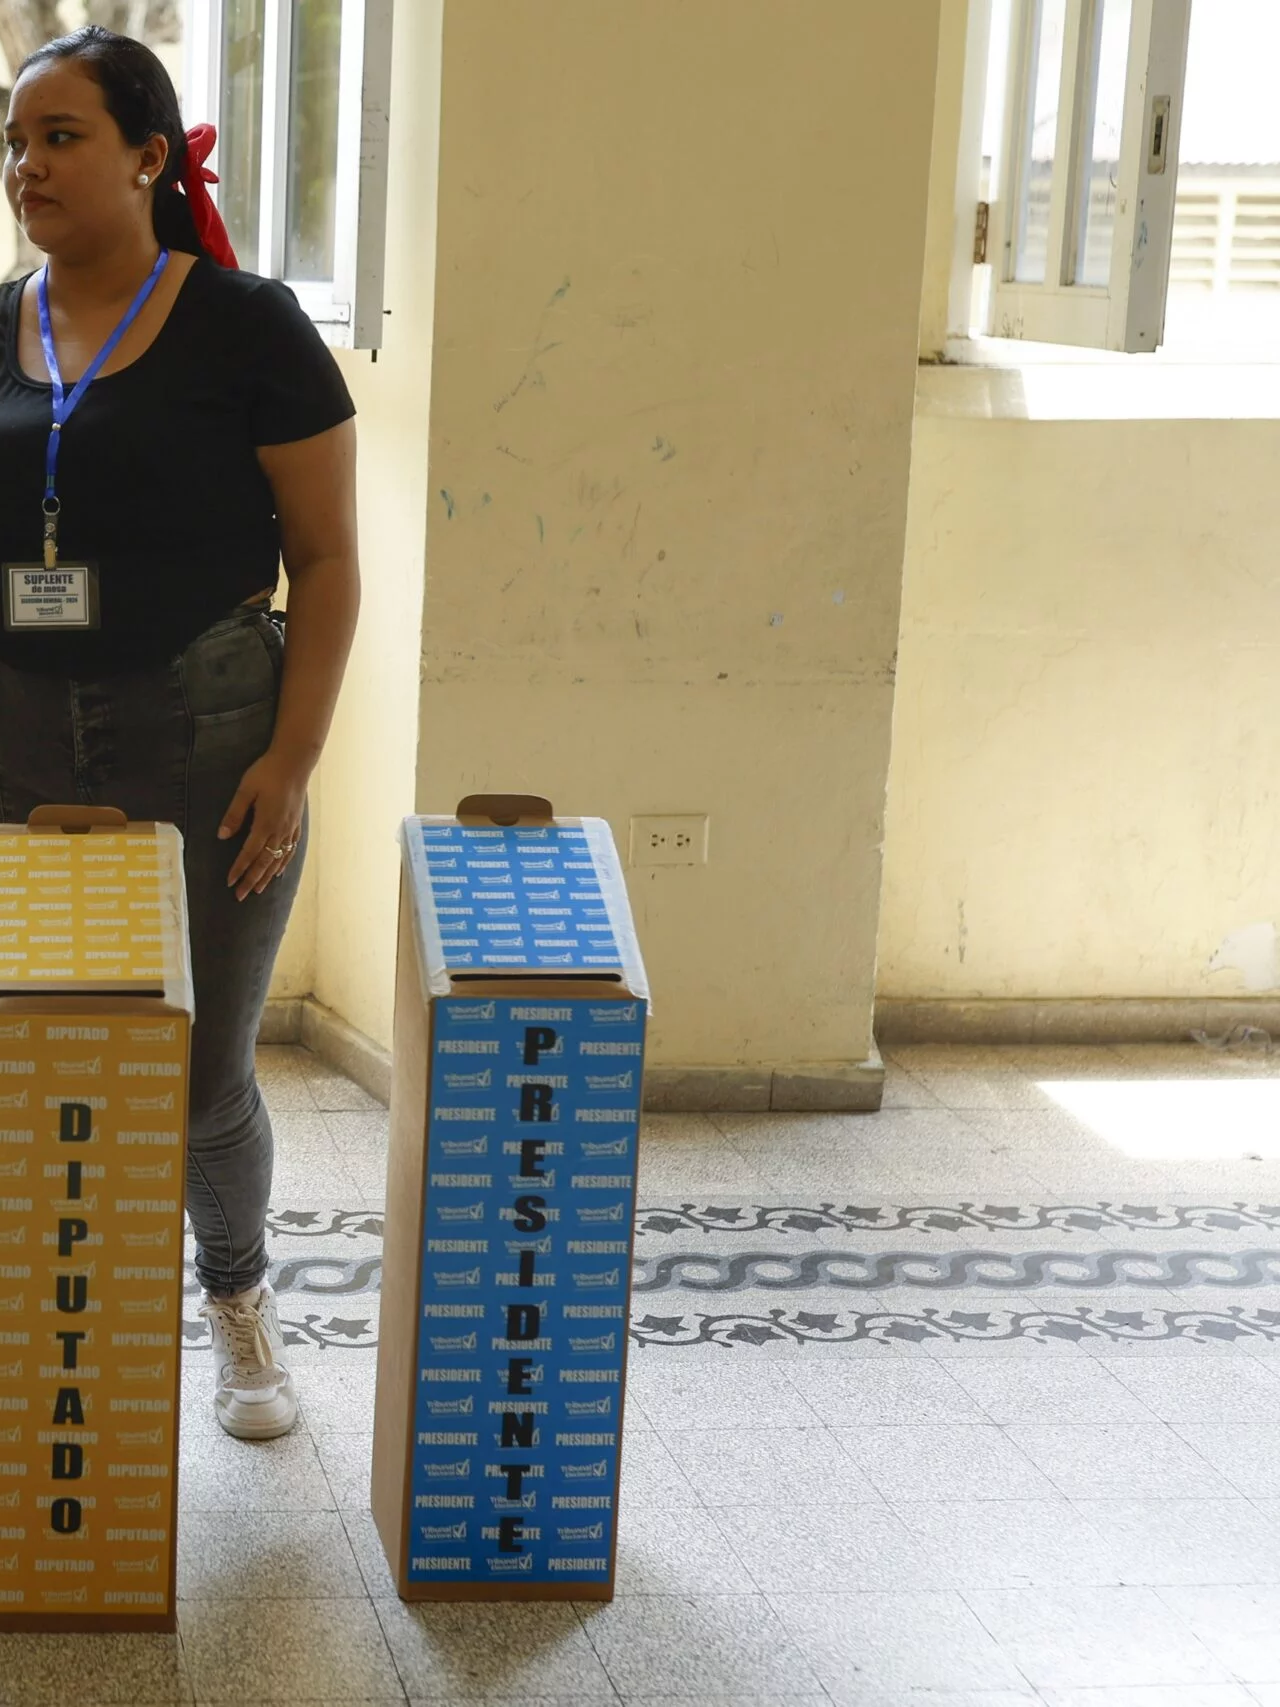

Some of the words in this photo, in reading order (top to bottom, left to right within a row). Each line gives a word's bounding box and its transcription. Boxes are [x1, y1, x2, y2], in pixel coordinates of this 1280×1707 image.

[24, 574, 74, 584] SUPLENTE
[510, 1008, 572, 1021] PRESIDENTE
[46, 1026, 109, 1040] DIPUTADO
[438, 1040, 500, 1054] PRESIDENTE
[580, 1042, 641, 1056] PRESIDENTE
[119, 1062, 181, 1076] DIPUTADO
[435, 1108, 496, 1121] PRESIDENTE
[575, 1109, 636, 1122] PRESIDENTE
[117, 1131, 179, 1145] DIPUTADO
[431, 1174, 492, 1187] PRESIDENTE
[571, 1175, 632, 1188] PRESIDENTE
[115, 1199, 176, 1212] DIPUTADO
[428, 1240, 488, 1253] PRESIDENTE
[567, 1240, 628, 1253] PRESIDENTE
[113, 1266, 174, 1280] DIPUTADO
[498, 1027, 558, 1552] PRESIDENTE
[424, 1304, 485, 1318] PRESIDENTE
[563, 1304, 624, 1318] PRESIDENTE
[50, 1103, 92, 1533] DIPUTADO
[112, 1332, 172, 1346] DIPUTADO
[422, 1369, 481, 1382] PRESIDENTE
[559, 1369, 619, 1382] PRESIDENTE
[110, 1399, 169, 1412] DIPUTADO
[488, 1401, 548, 1415] PRESIDENTE
[37, 1431, 98, 1445] DIPUTADO
[418, 1432, 478, 1445] PRESIDENTE
[555, 1433, 615, 1446] PRESIDENTE
[108, 1464, 168, 1477] DIPUTADO
[415, 1495, 475, 1508] PRESIDENTE
[552, 1496, 611, 1509] PRESIDENTE
[106, 1528, 166, 1541] DIPUTADO
[35, 1560, 95, 1572] DIPUTADO
[412, 1557, 471, 1570] PRESIDENTE
[548, 1558, 607, 1570] PRESIDENTE
[104, 1591, 164, 1604] DIPUTADO
